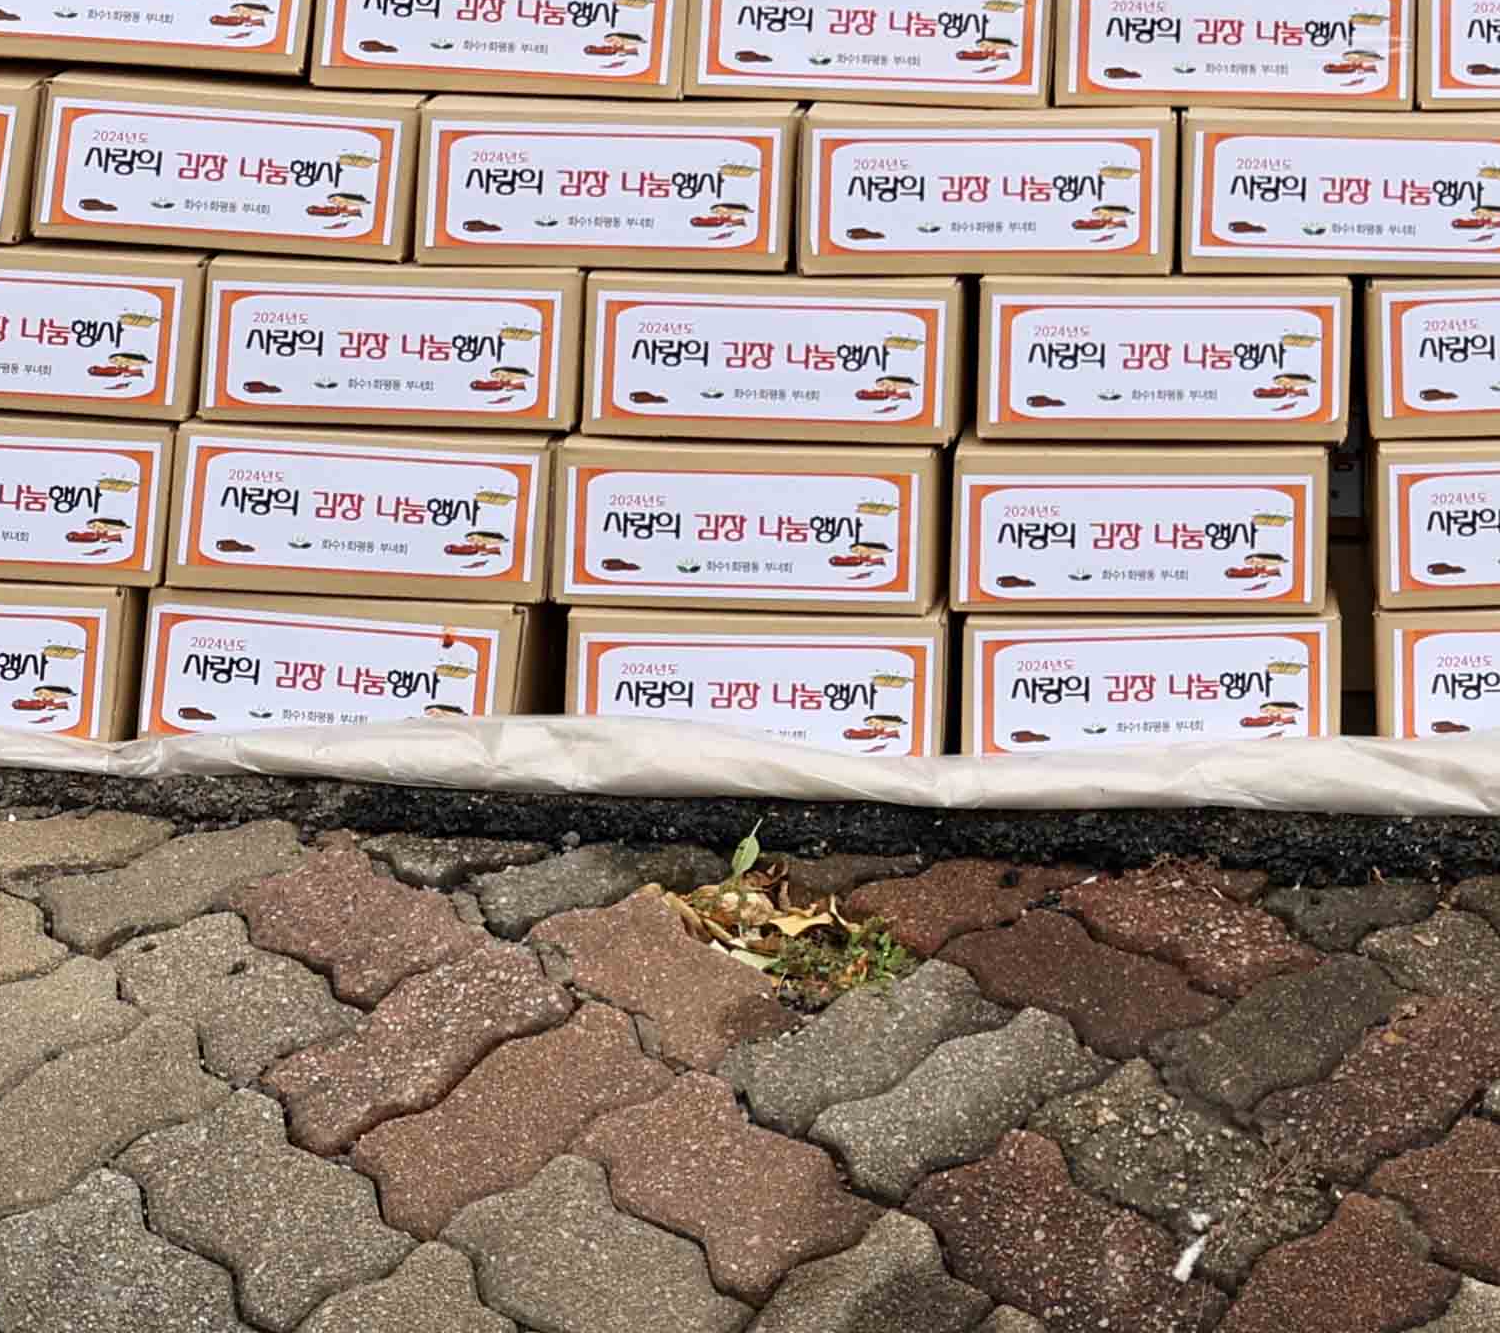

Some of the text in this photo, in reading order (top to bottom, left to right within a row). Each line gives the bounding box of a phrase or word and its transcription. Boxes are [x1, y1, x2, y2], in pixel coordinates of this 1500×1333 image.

[465, 168, 545, 197] 사랑의
[557, 170, 611, 199] 김장
[631, 339, 710, 368] 사랑의
[722, 341, 776, 371] 김장
